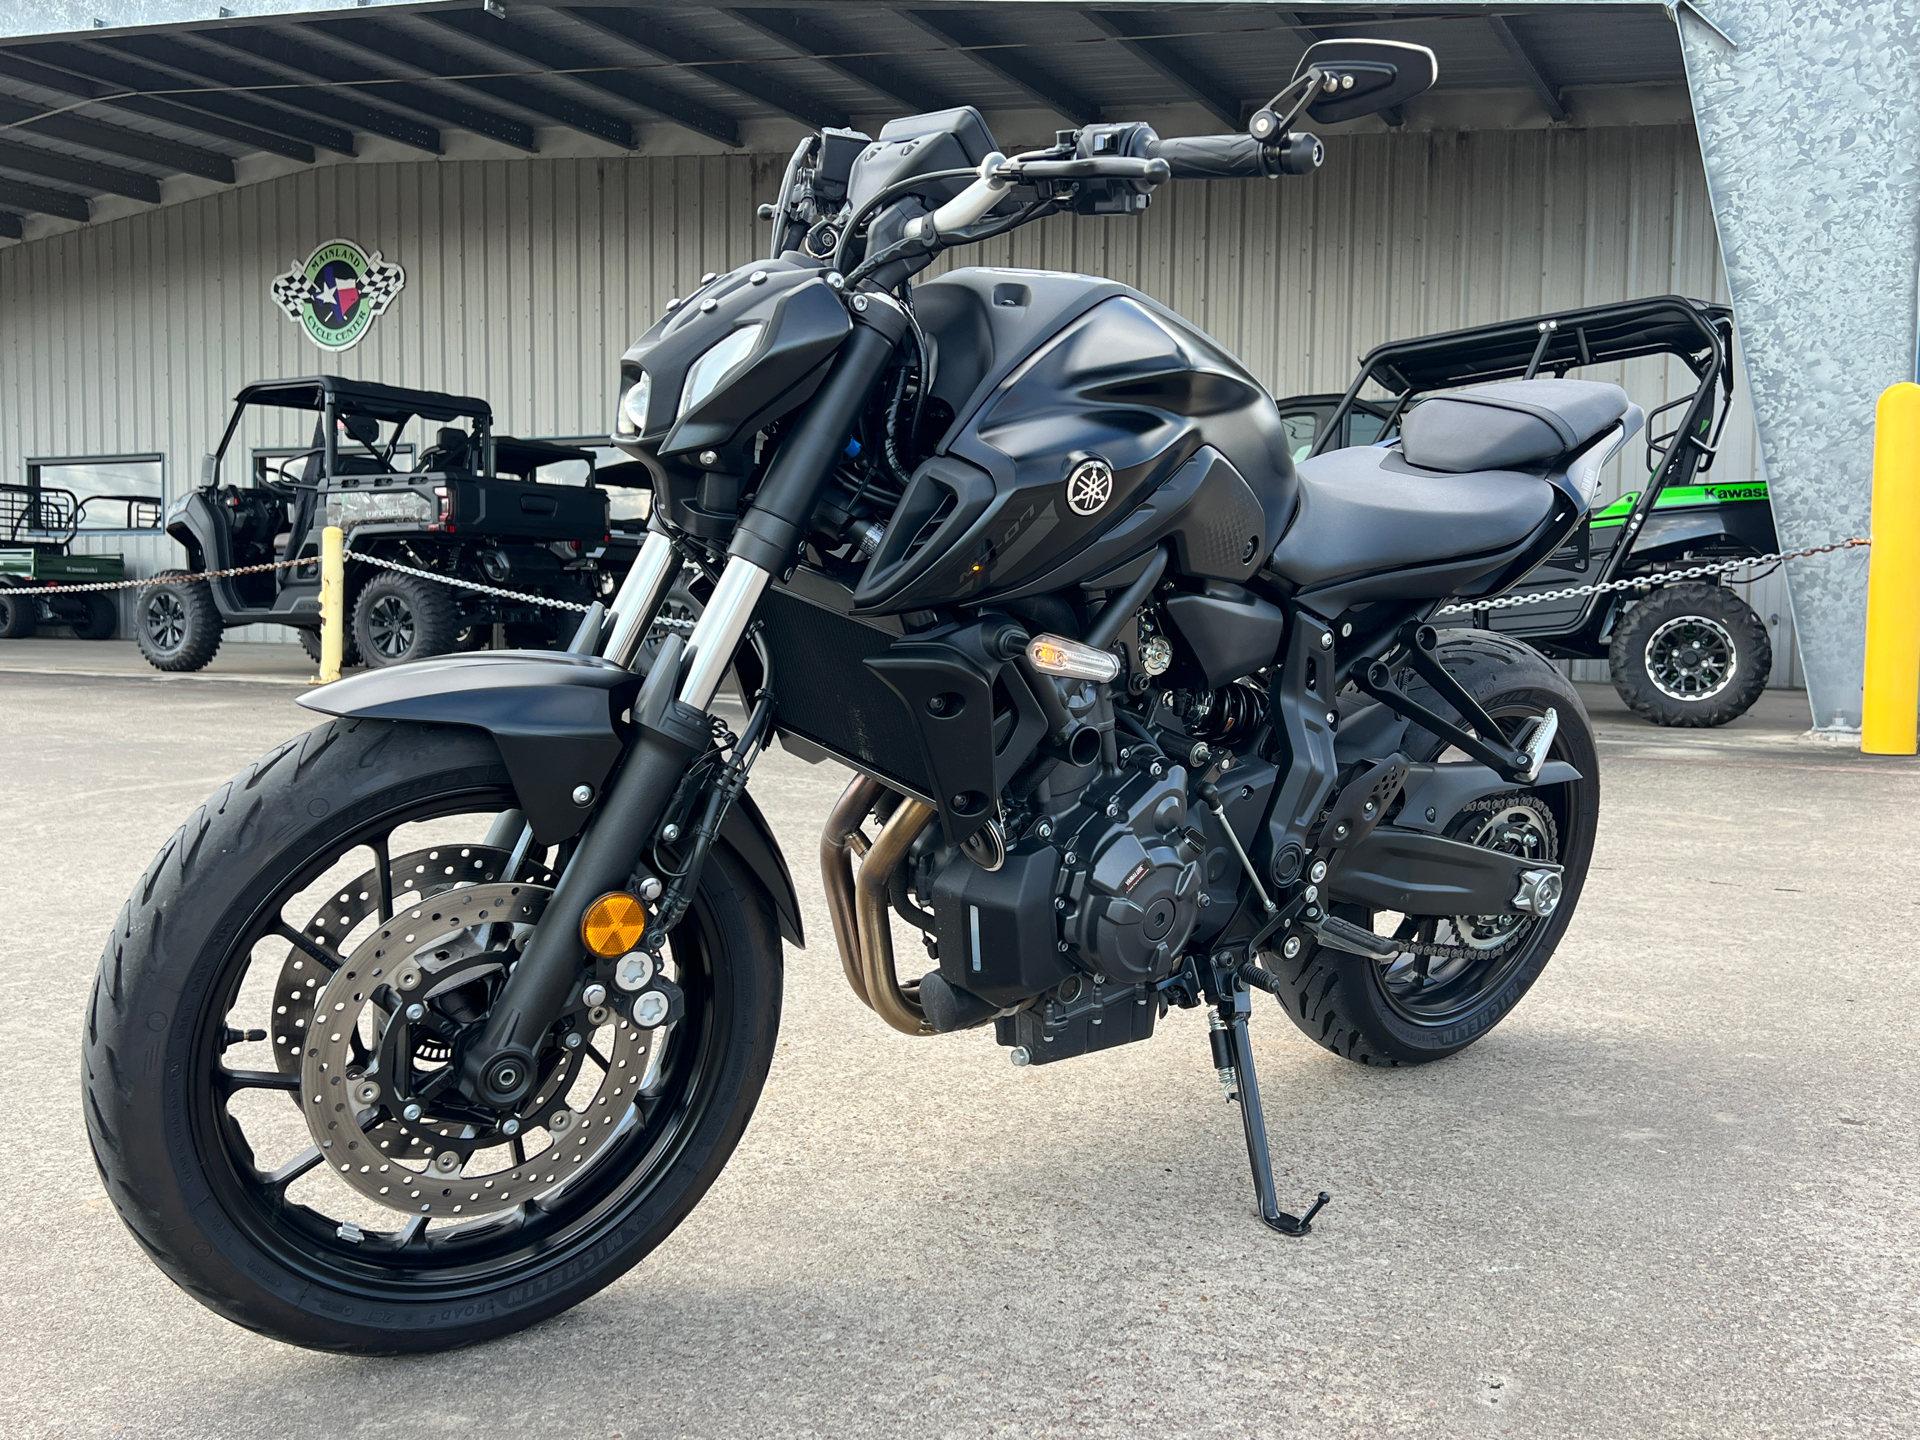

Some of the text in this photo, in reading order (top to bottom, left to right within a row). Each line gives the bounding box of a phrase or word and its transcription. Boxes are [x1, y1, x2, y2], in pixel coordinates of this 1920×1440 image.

[311, 248, 361, 272] MAINLAND
[307, 310, 367, 341] CYCLE CENTER
[324, 774, 461, 834] MICHELIN
[1442, 984, 1521, 1043] MICHELIN
[507, 1235, 624, 1305] MICHELIN
[441, 1303, 487, 1321] ROAD
